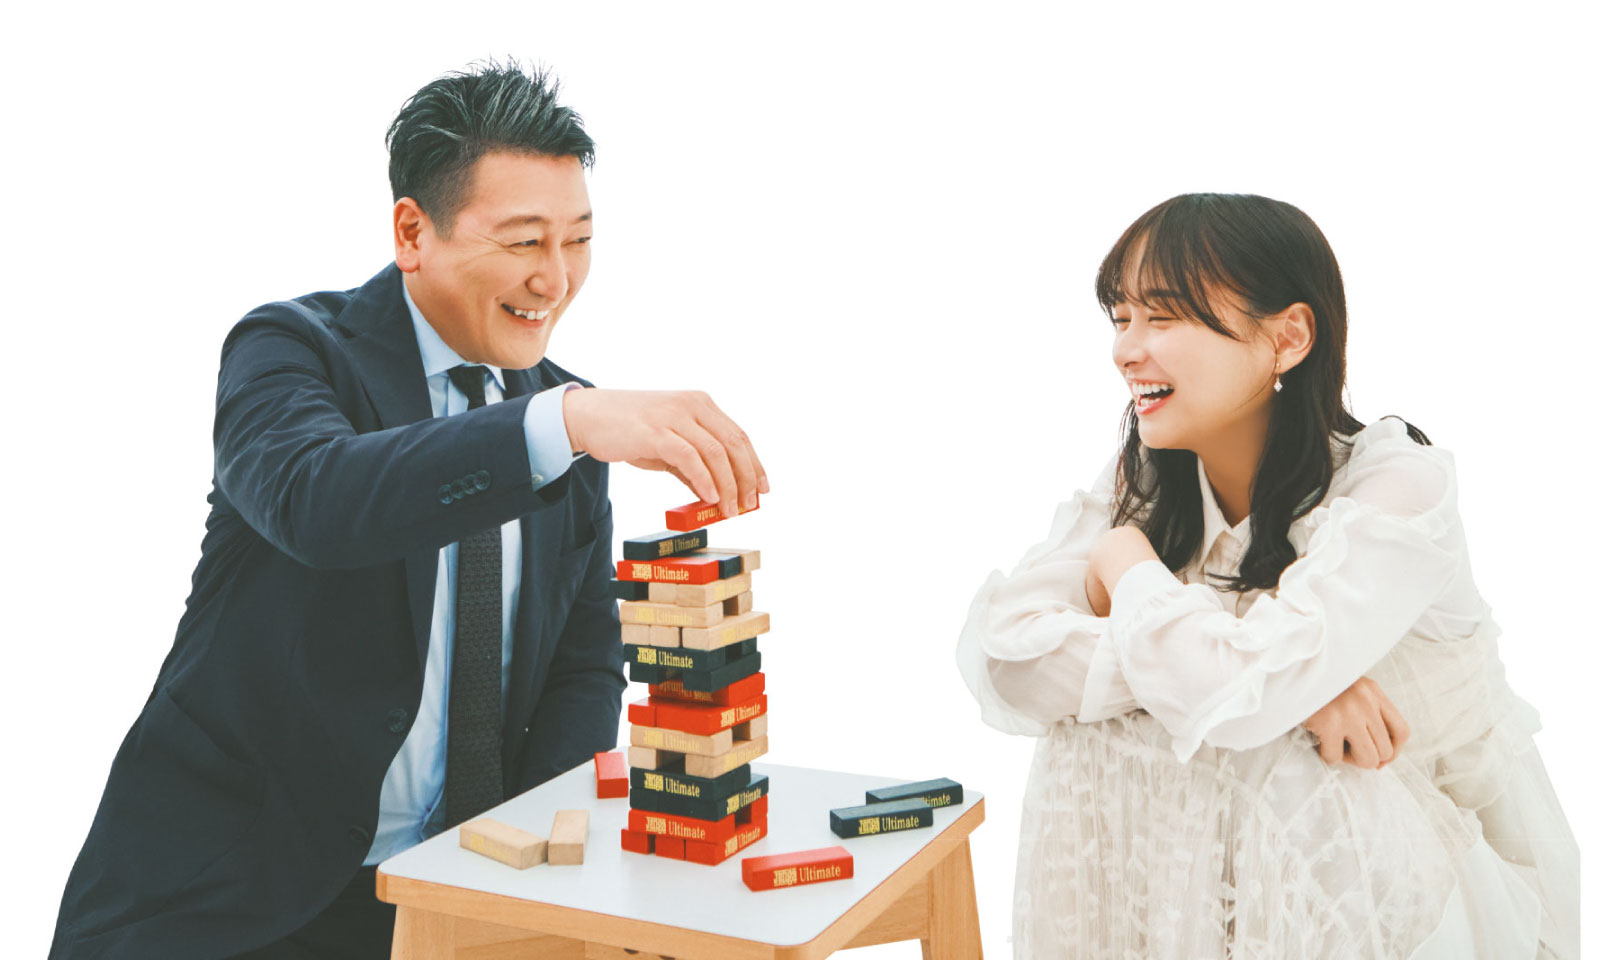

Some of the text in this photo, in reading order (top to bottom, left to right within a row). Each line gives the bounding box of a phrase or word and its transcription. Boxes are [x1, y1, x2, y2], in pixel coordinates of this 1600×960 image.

[674, 537, 699, 552] Ultimate
[654, 566, 689, 580] Ultimate
[658, 650, 693, 668] Ultimate
[736, 703, 760, 722] Ultimate
[665, 778, 701, 798] Ultimate
[740, 787, 762, 808] Ultimate
[668, 820, 706, 840] Ultimate
[882, 815, 920, 832] Ultimate
[738, 826, 760, 849] Ultimate
[800, 864, 841, 882] Ultimate
